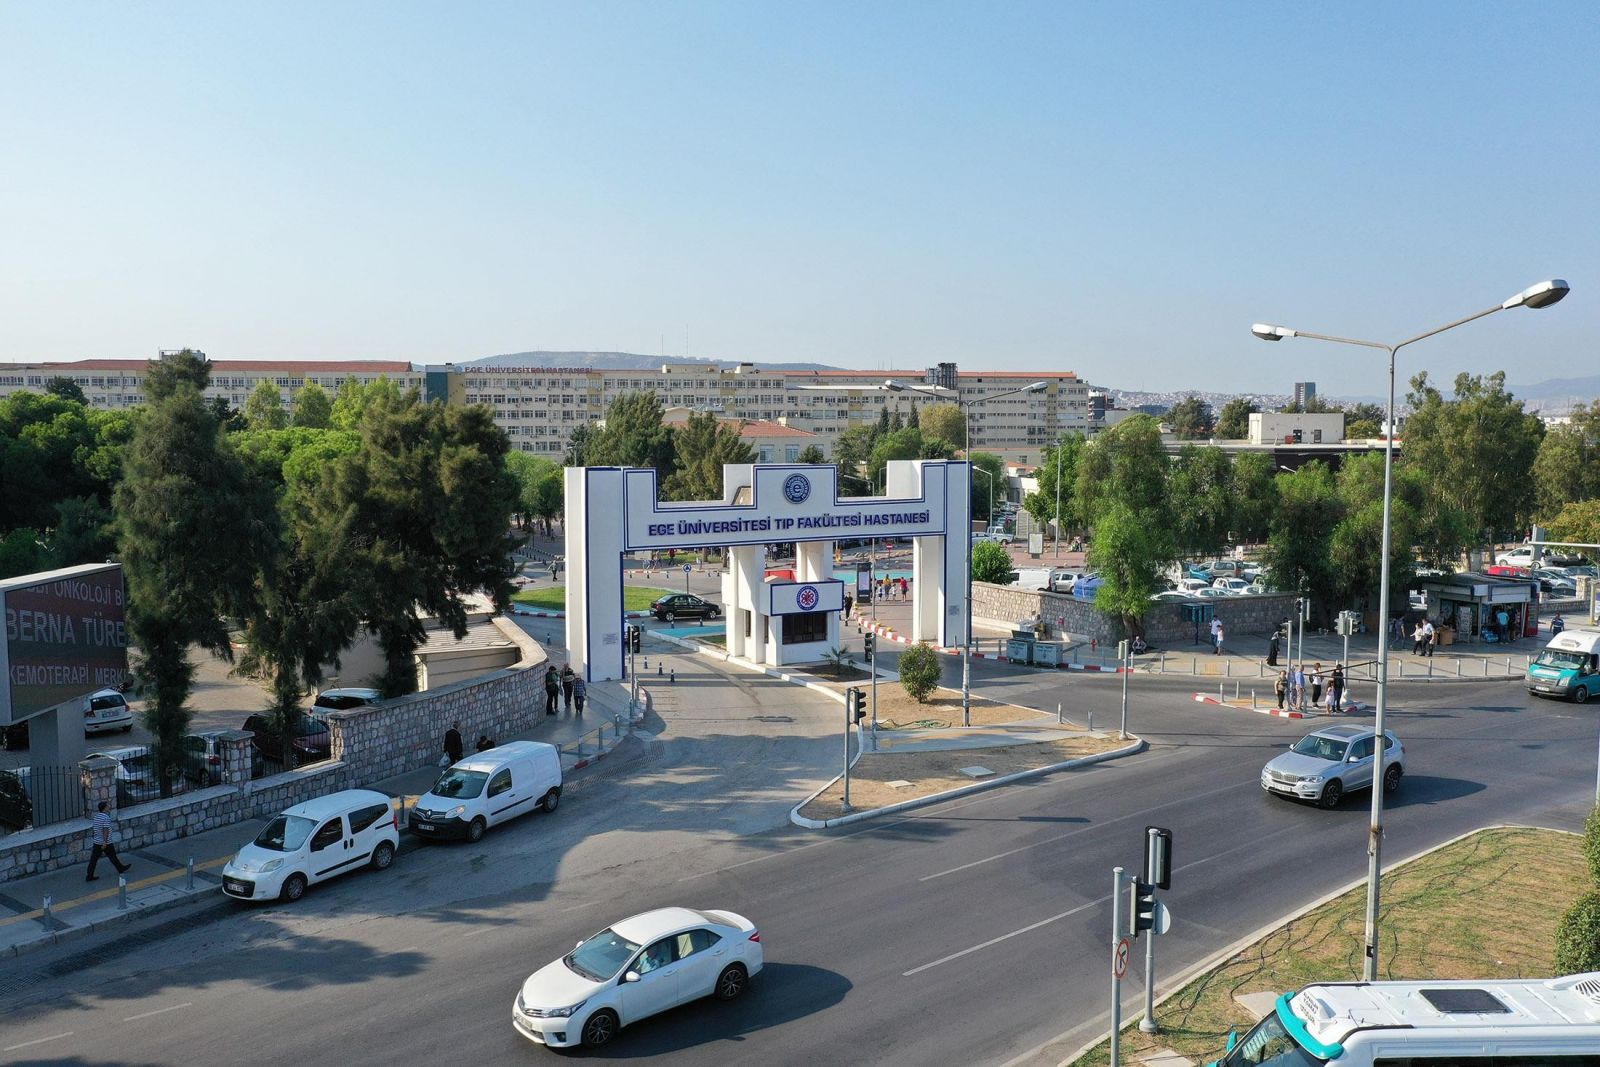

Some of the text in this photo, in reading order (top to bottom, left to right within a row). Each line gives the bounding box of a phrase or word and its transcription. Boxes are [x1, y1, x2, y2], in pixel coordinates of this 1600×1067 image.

[648, 509, 930, 536] EGE ÜNİVERSİTESİ TIP FAKÜLTESİ HASTANESİ
[7, 607, 76, 645] BERNA
[10, 664, 89, 686] KEMOTERAPİ
